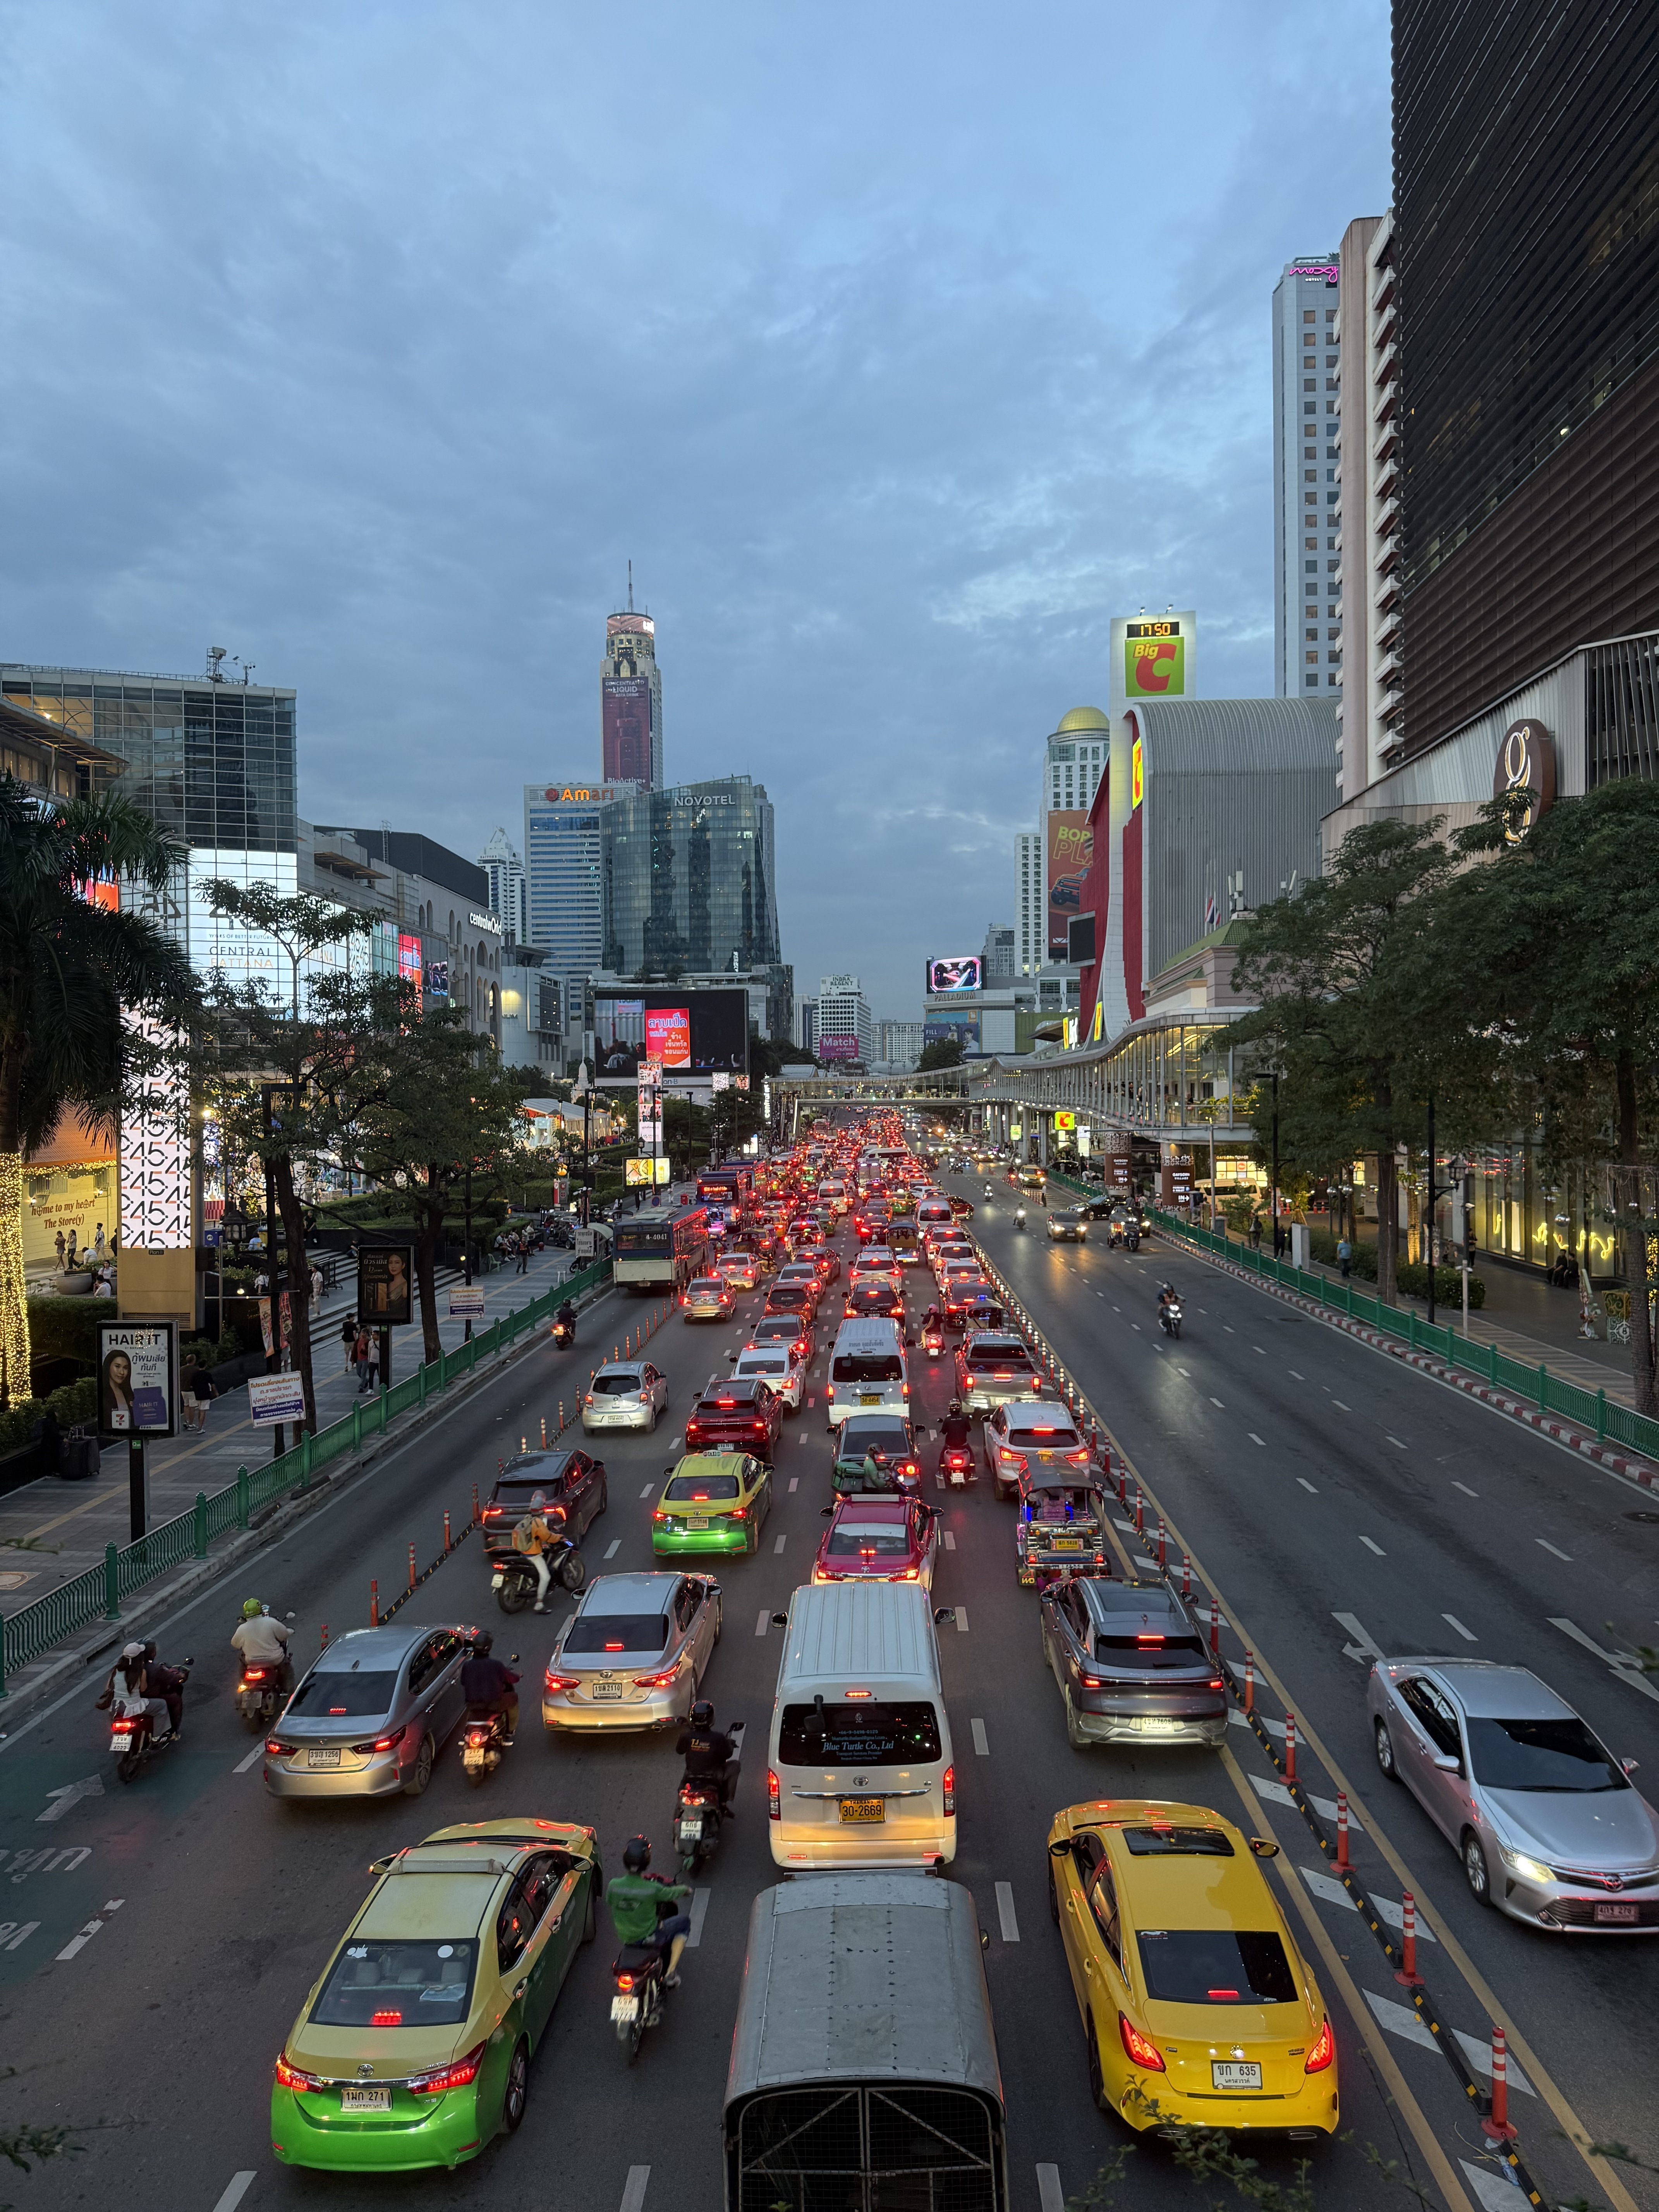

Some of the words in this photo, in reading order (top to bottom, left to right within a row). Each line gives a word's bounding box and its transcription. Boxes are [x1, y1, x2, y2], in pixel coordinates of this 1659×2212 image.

[1133, 643, 1159, 658] Big
[1136, 643, 1177, 692] C
[561, 788, 613, 801] Amari
[675, 795, 735, 807] NOVOTEL
[210, 946, 270, 956] CENTRAL
[934, 991, 976, 1001] PALLADIUM
[648, 1012, 687, 1028] ลาบเป็ด
[823, 1037, 855, 1046] Match
[55, 1204, 62, 1212] to
[64, 1203, 73, 1212] my
[44, 1218, 57, 1229] The
[58, 1213, 84, 1226] Store(y)
[109, 1334, 144, 1345] HAIR
[141, 1363, 157, 1371] ทันที
[823, 1742, 840, 1750] Blue
[842, 1742, 864, 1750] Turtle
[866, 1741, 880, 1750] Co.,
[881, 1741, 894, 1749] Ltd
[842, 1805, 881, 1817] 30-2669
[1217, 2065, 1231, 2076] ขก
[1239, 2066, 1256, 2076] 635
[346, 2092, 364, 2101] 1มก
[368, 2091, 383, 2101] 271
